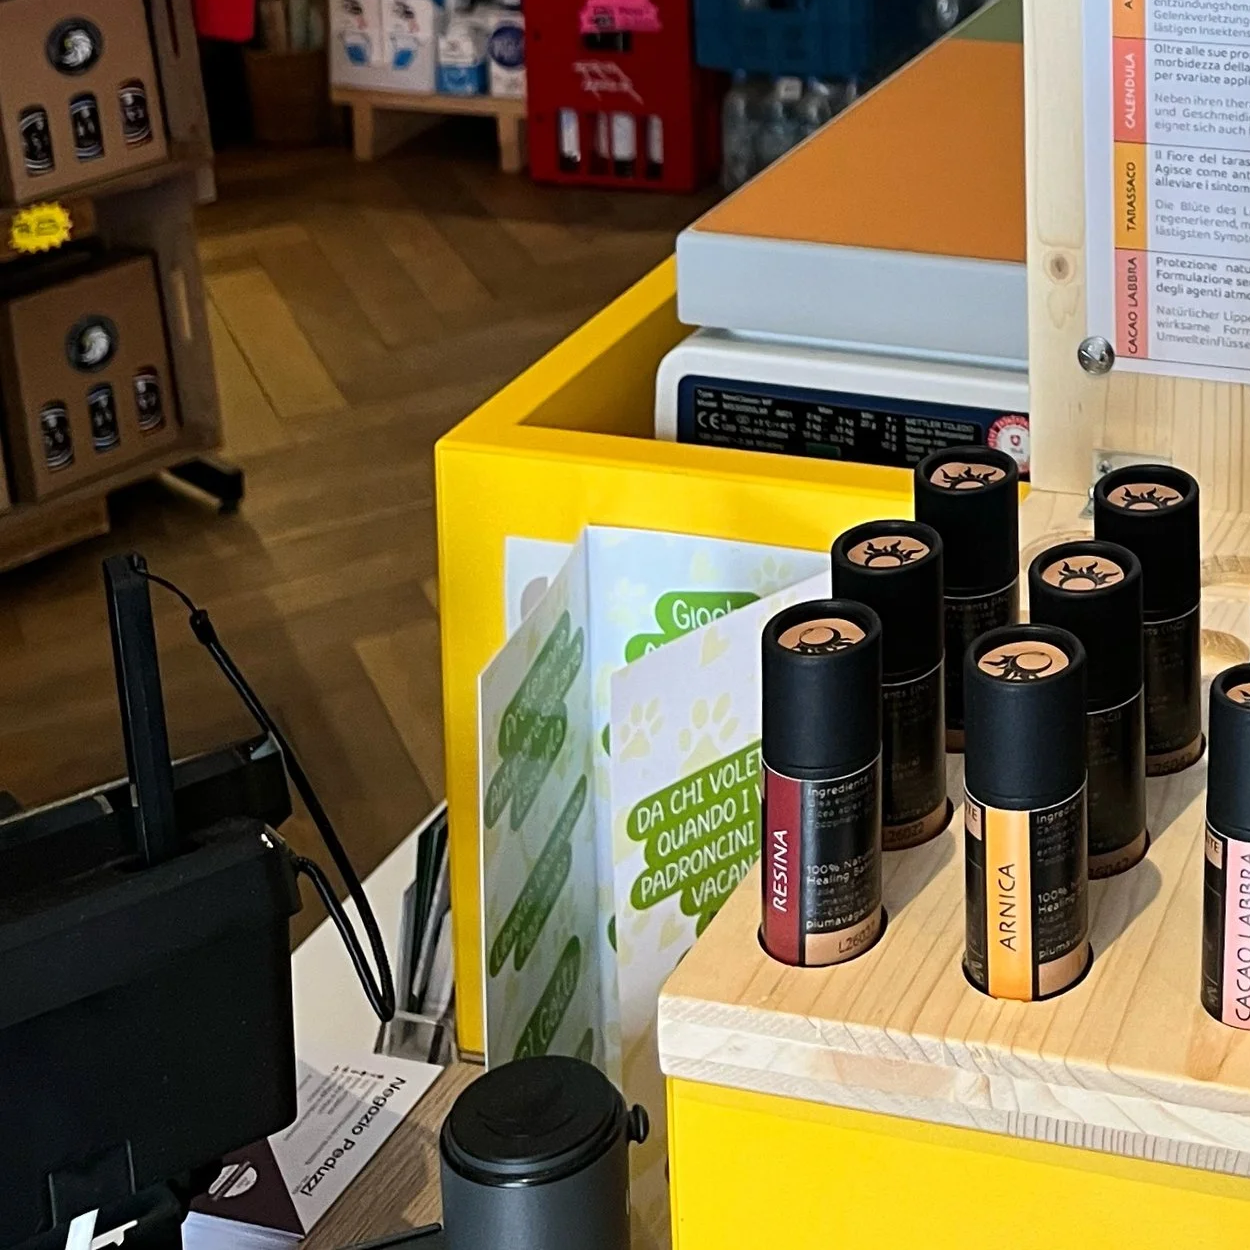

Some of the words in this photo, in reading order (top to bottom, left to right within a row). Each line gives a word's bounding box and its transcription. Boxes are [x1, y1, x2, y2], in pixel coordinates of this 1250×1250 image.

[1124, 52, 1136, 130] CALENDULA
[1153, 57, 1220, 70] morbidezza
[1223, 61, 1250, 72] della
[1126, 161, 1136, 233] TARASSACO
[1154, 162, 1192, 174] Agisce
[1195, 168, 1227, 177] come
[1128, 257, 1139, 310] LABBRA
[1156, 268, 1233, 284] Formulazione
[1128, 314, 1139, 355] CACAO
[637, 802, 665, 832] DA
[671, 778, 704, 812] CHI
[709, 747, 762, 794] VOLET
[657, 797, 737, 858] QUANDO
[640, 820, 755, 903] PADRONCINI
[773, 830, 788, 912] RESINA
[806, 863, 840, 877] 100%
[807, 871, 850, 887] Healing
[998, 863, 1017, 952] ARNICA
[352, 1076, 406, 1136] Negozio
[300, 1138, 356, 1197] Peduzzi
